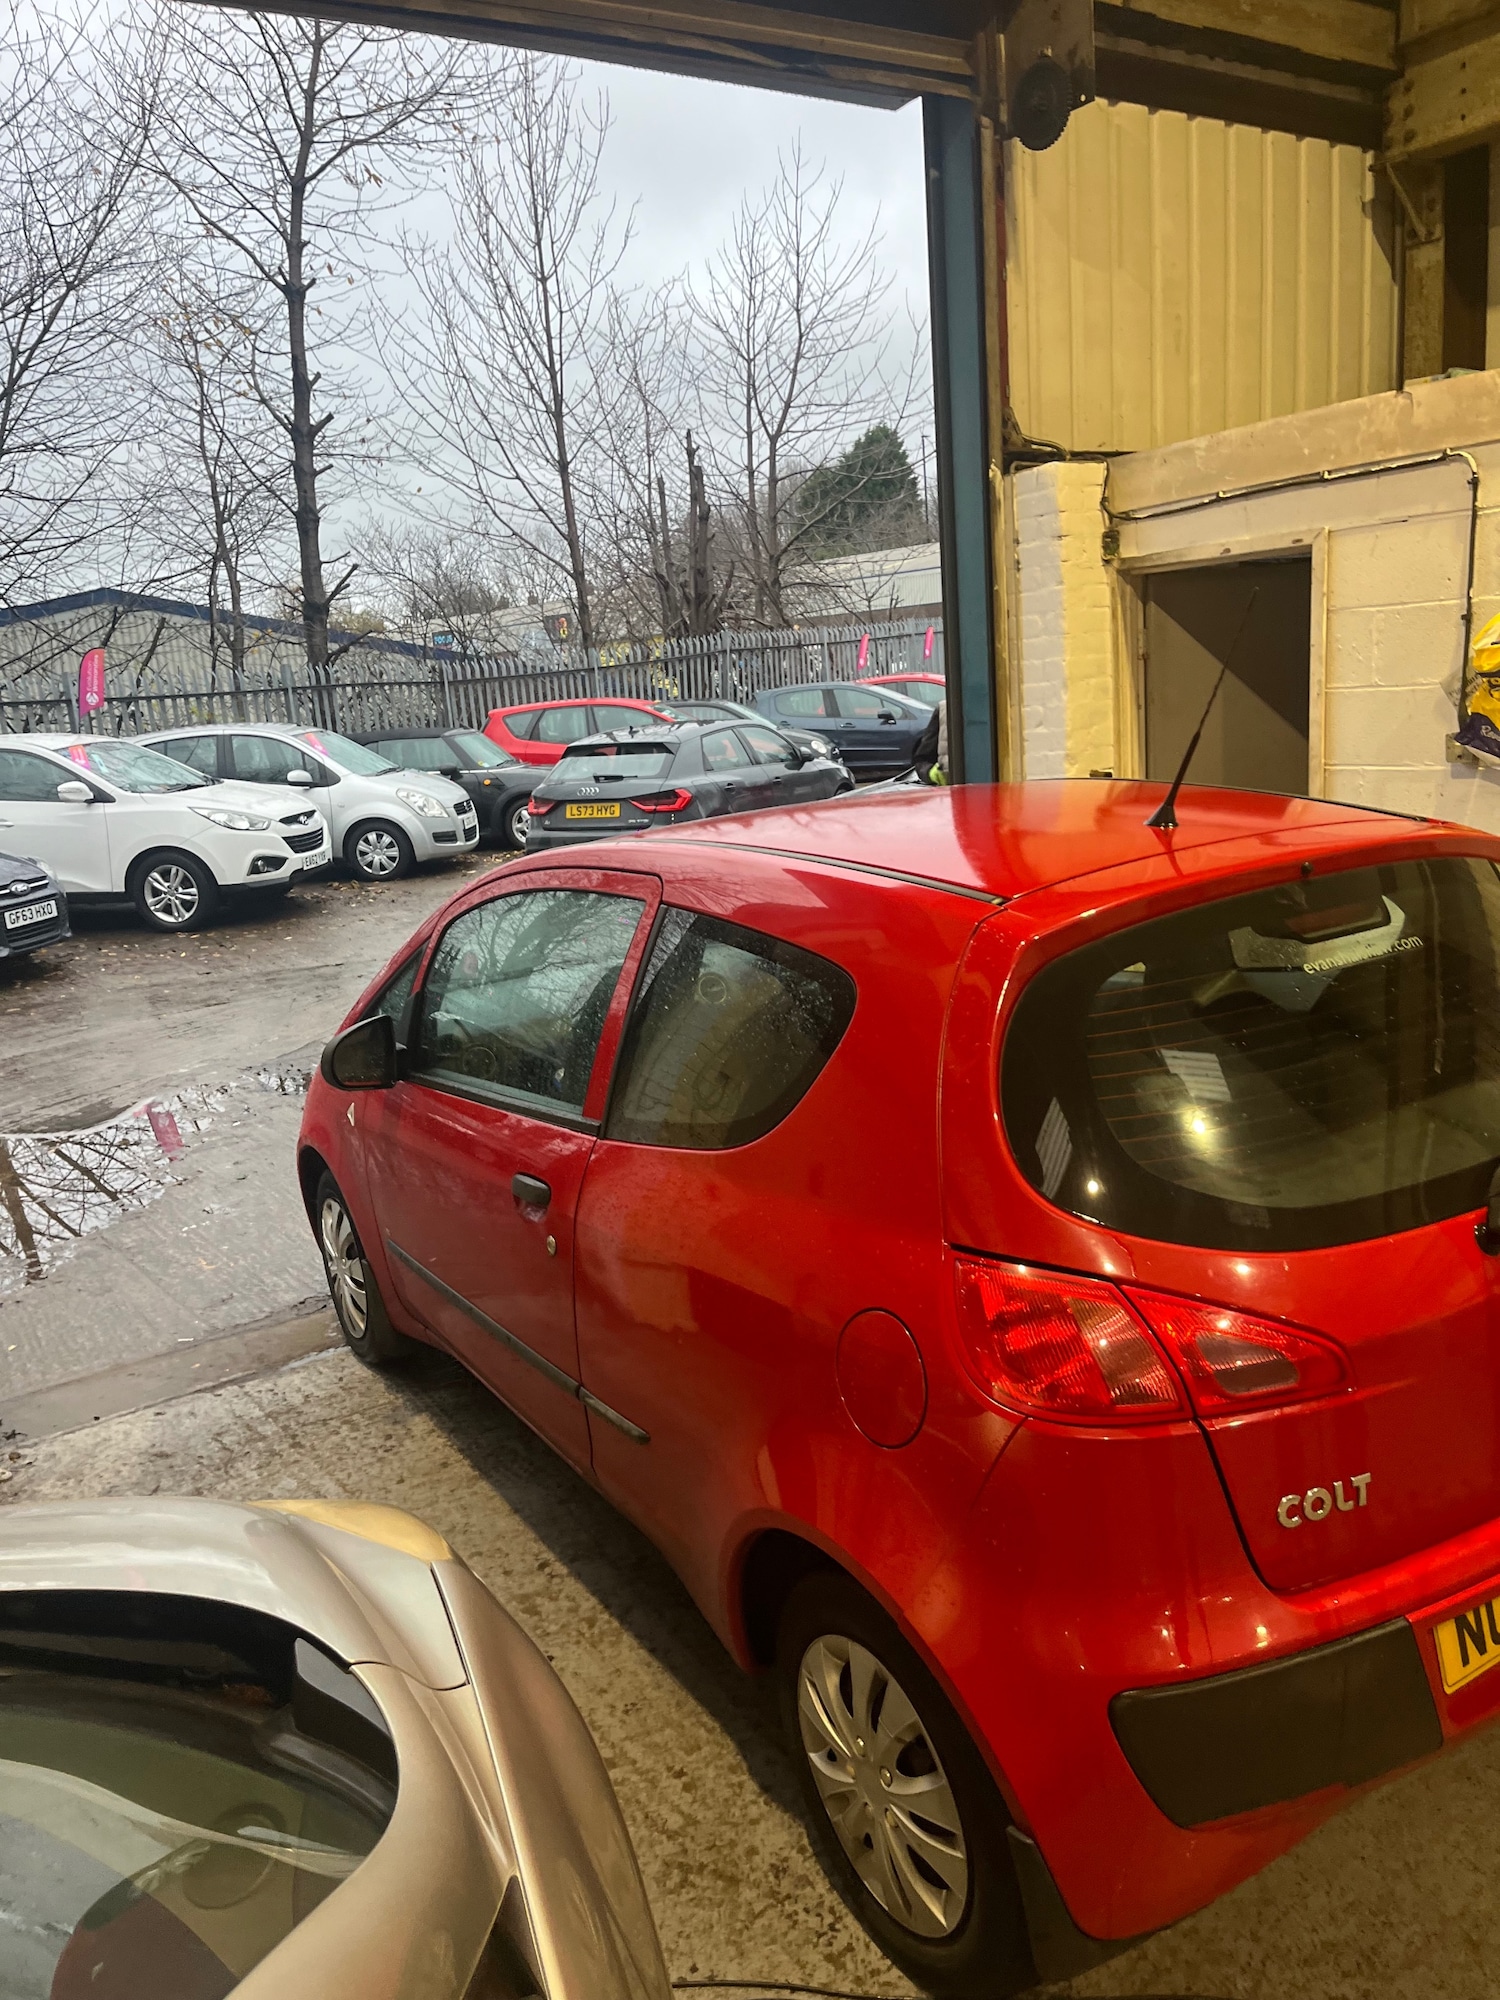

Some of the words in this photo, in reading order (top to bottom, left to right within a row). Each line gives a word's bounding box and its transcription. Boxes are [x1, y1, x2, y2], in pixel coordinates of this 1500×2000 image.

[570, 806, 594, 817] LS73
[596, 805, 615, 816] HYG
[9, 907, 33, 925] GF63
[34, 902, 53, 918] HXO
[1277, 1472, 1372, 1528] COLT
